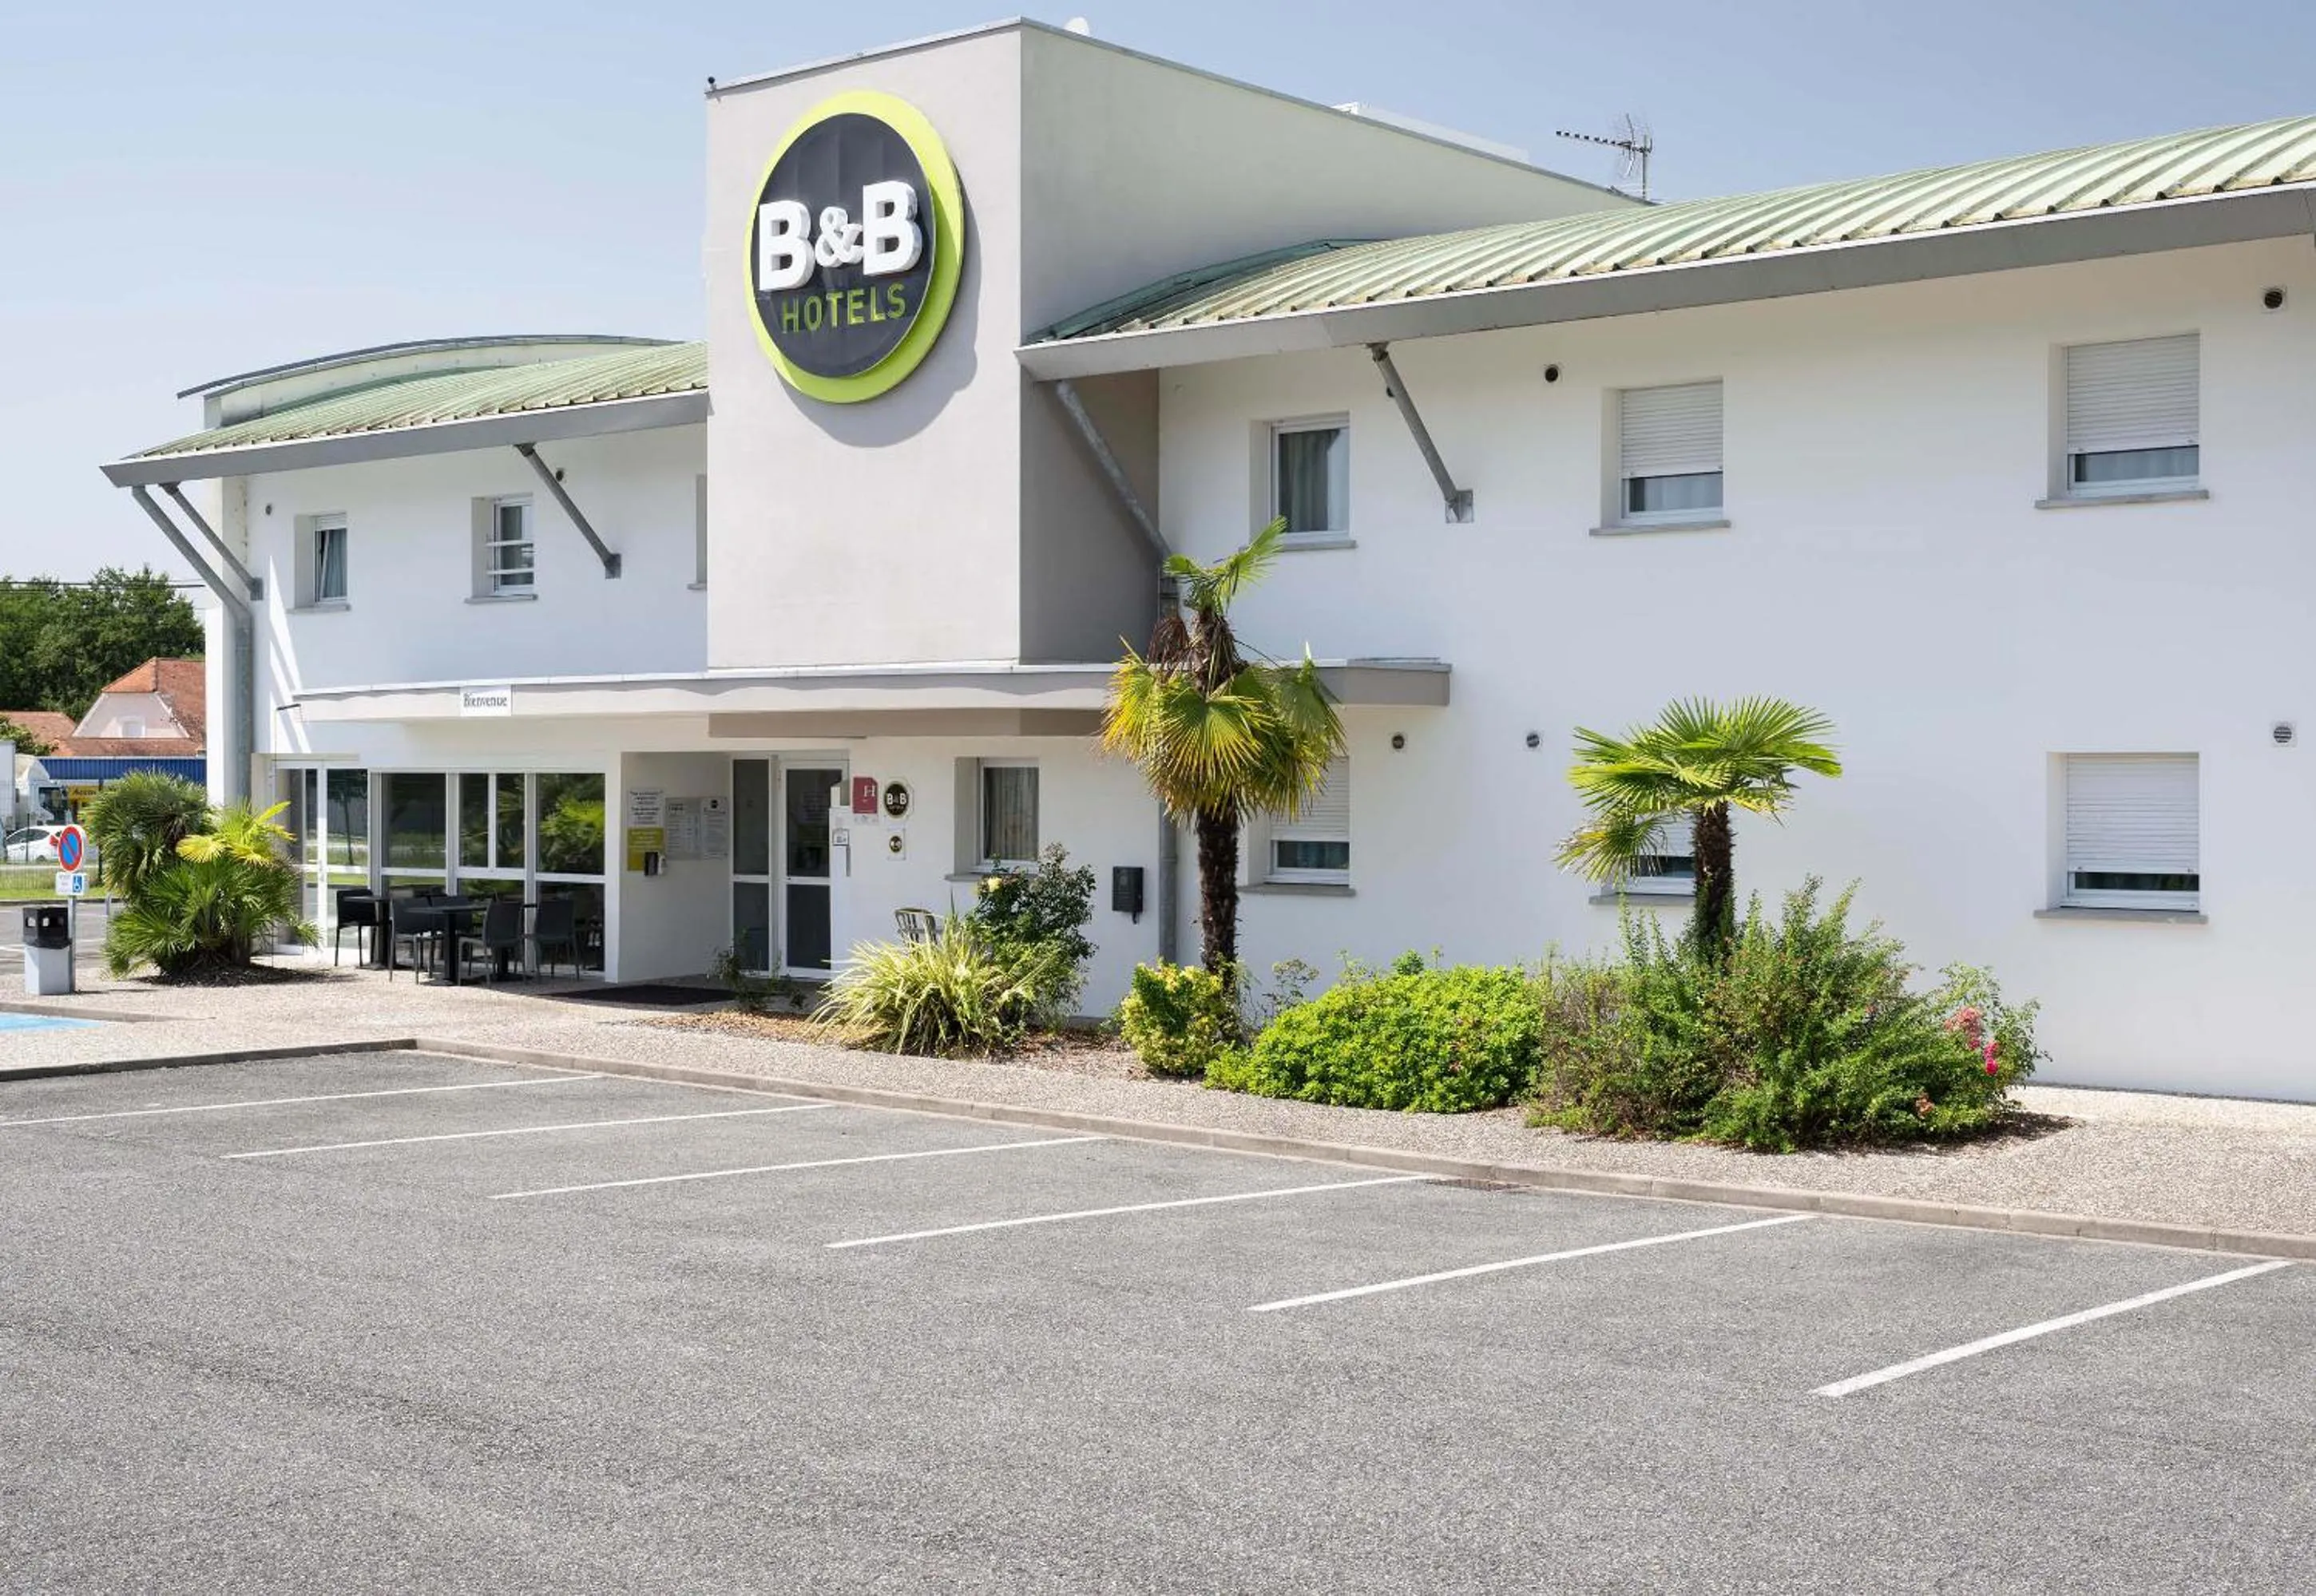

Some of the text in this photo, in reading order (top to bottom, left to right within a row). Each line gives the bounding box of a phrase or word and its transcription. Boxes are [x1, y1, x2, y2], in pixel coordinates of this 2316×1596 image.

[759, 180, 923, 291] B&B
[781, 283, 908, 335] HOTELS
[463, 692, 508, 708] Bienvenue
[863, 785, 875, 798] H
